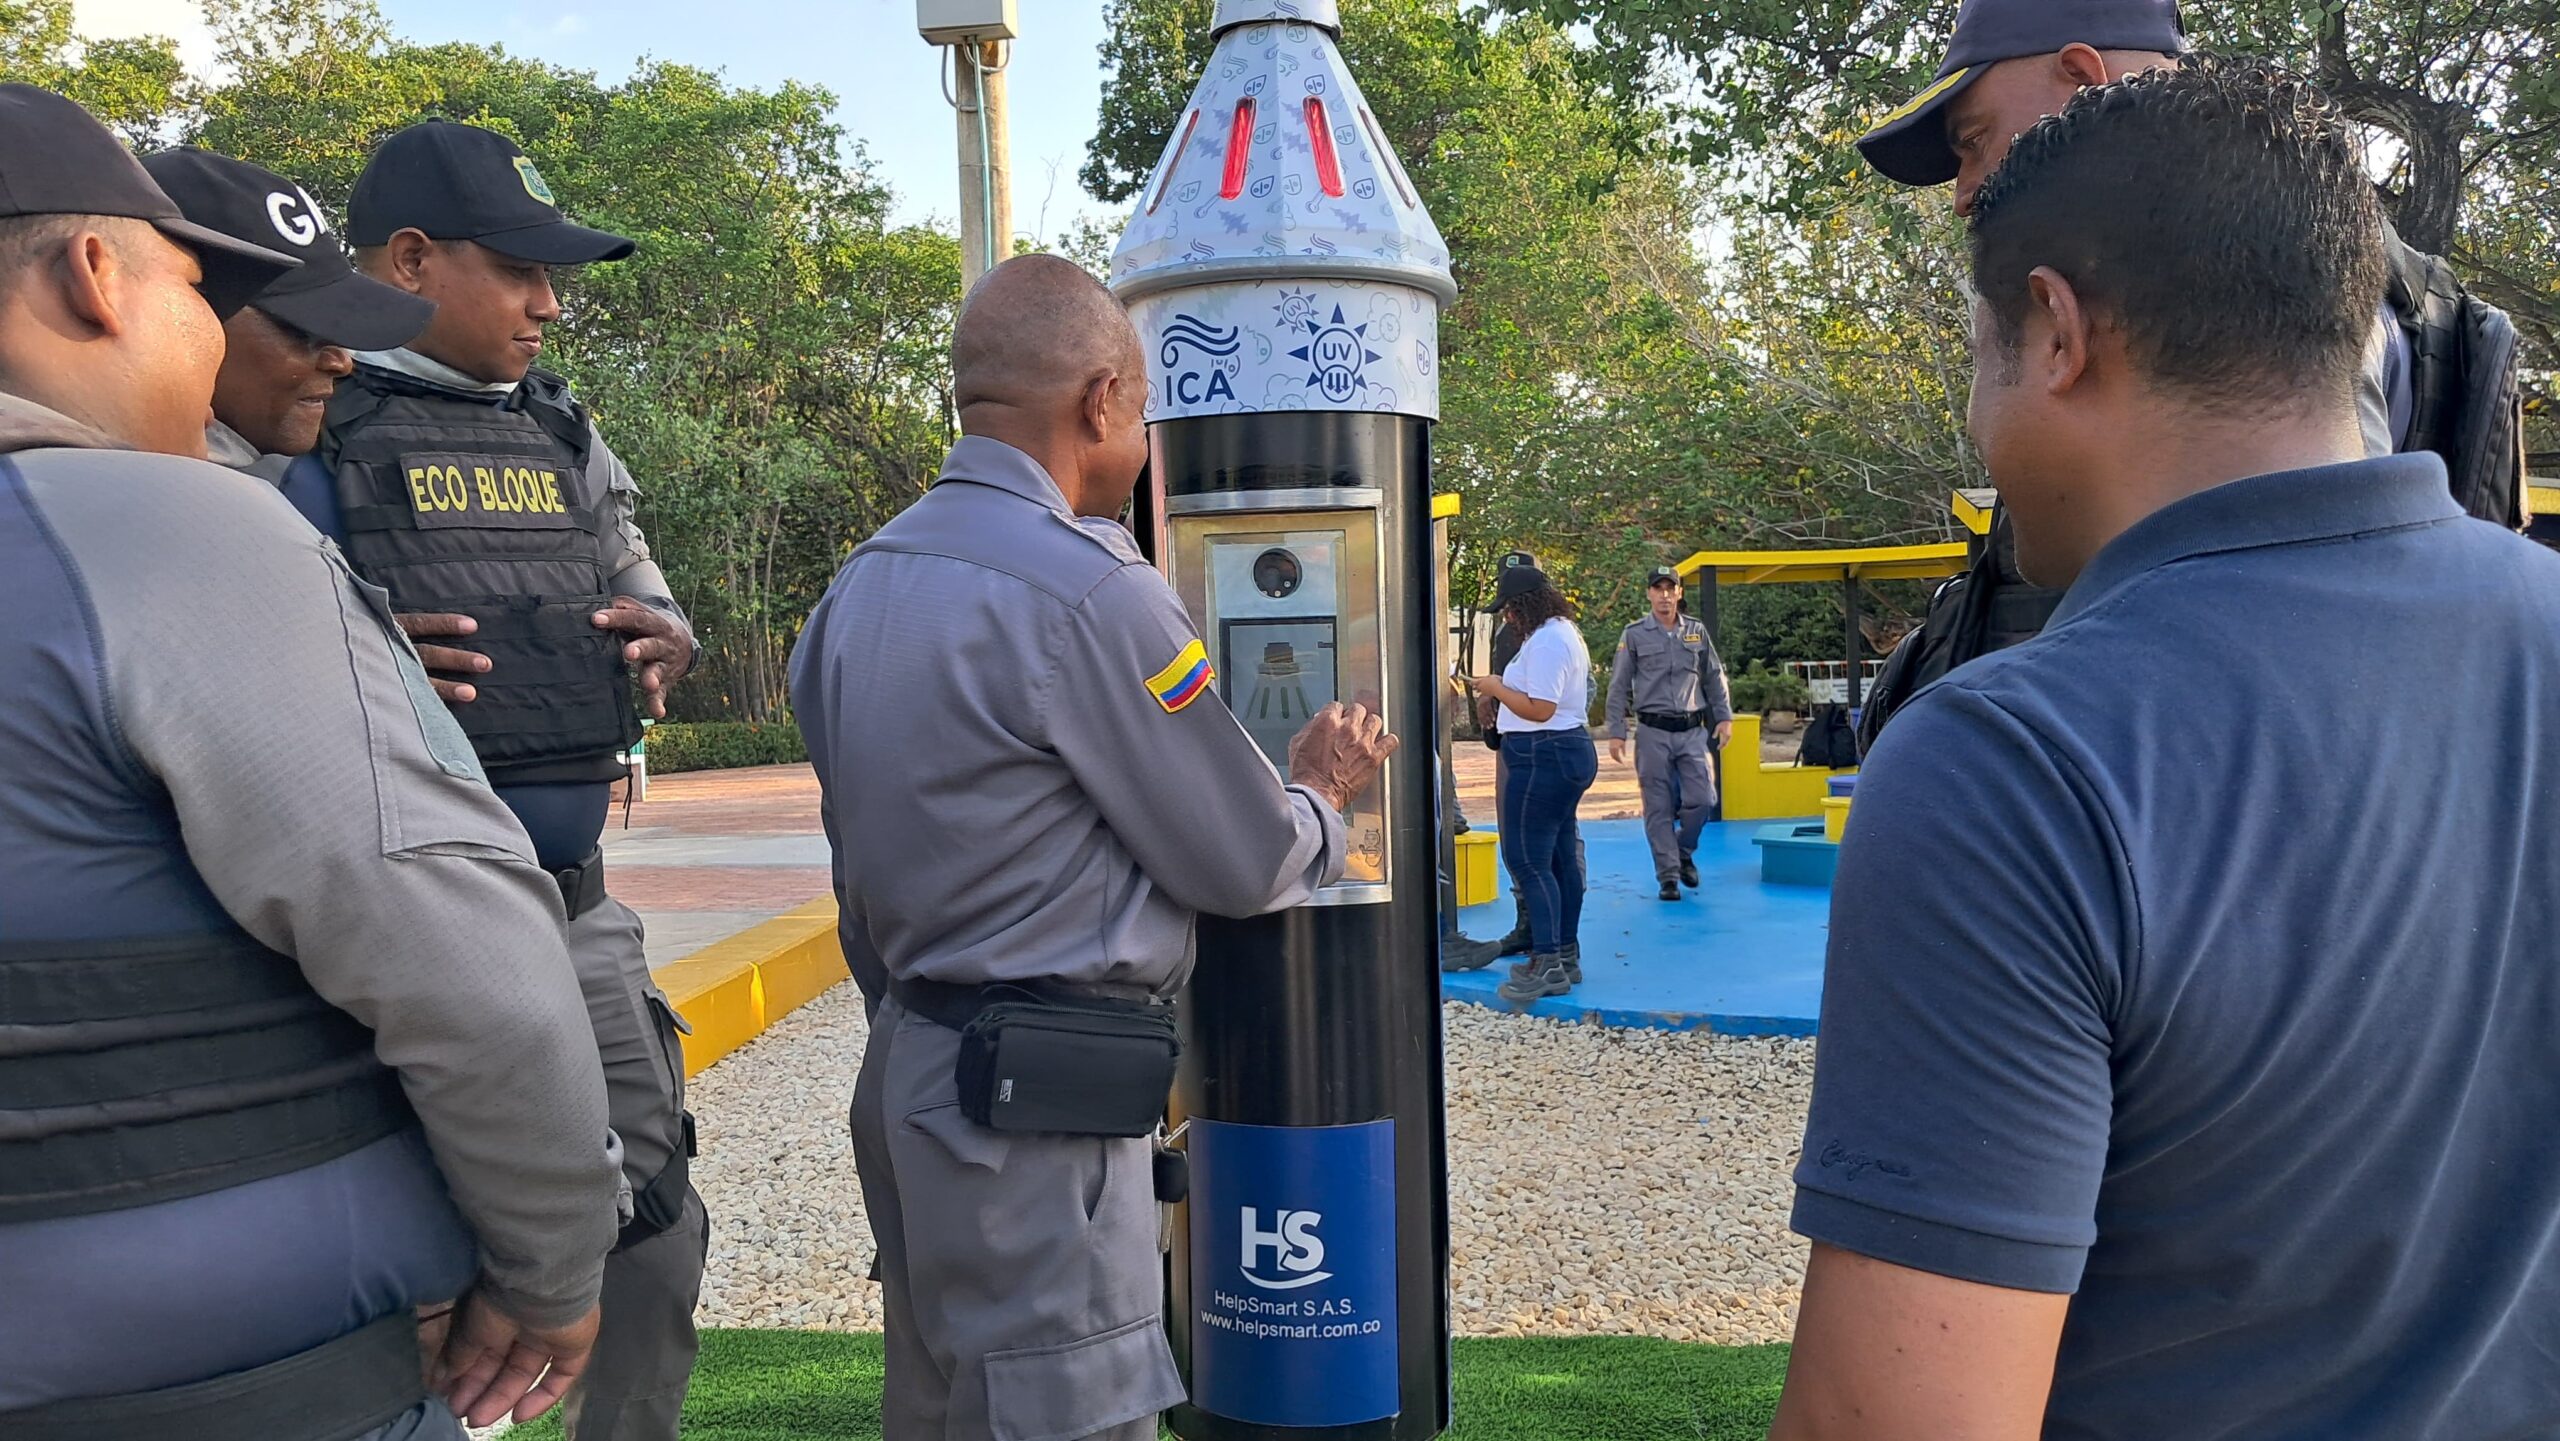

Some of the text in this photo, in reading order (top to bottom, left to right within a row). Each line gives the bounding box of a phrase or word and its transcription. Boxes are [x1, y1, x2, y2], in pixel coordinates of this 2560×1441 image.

[1286, 301, 1302, 318] UV
[1322, 342, 1352, 361] UV
[1166, 369, 1236, 407] ICA
[408, 465, 565, 514] ECO BLOQUE
[1241, 1206, 1325, 1271] HS
[1215, 1290, 1356, 1316] HelpSmart S.A.S.
[1201, 1310, 1381, 1339] www.helpsmart.com.co
